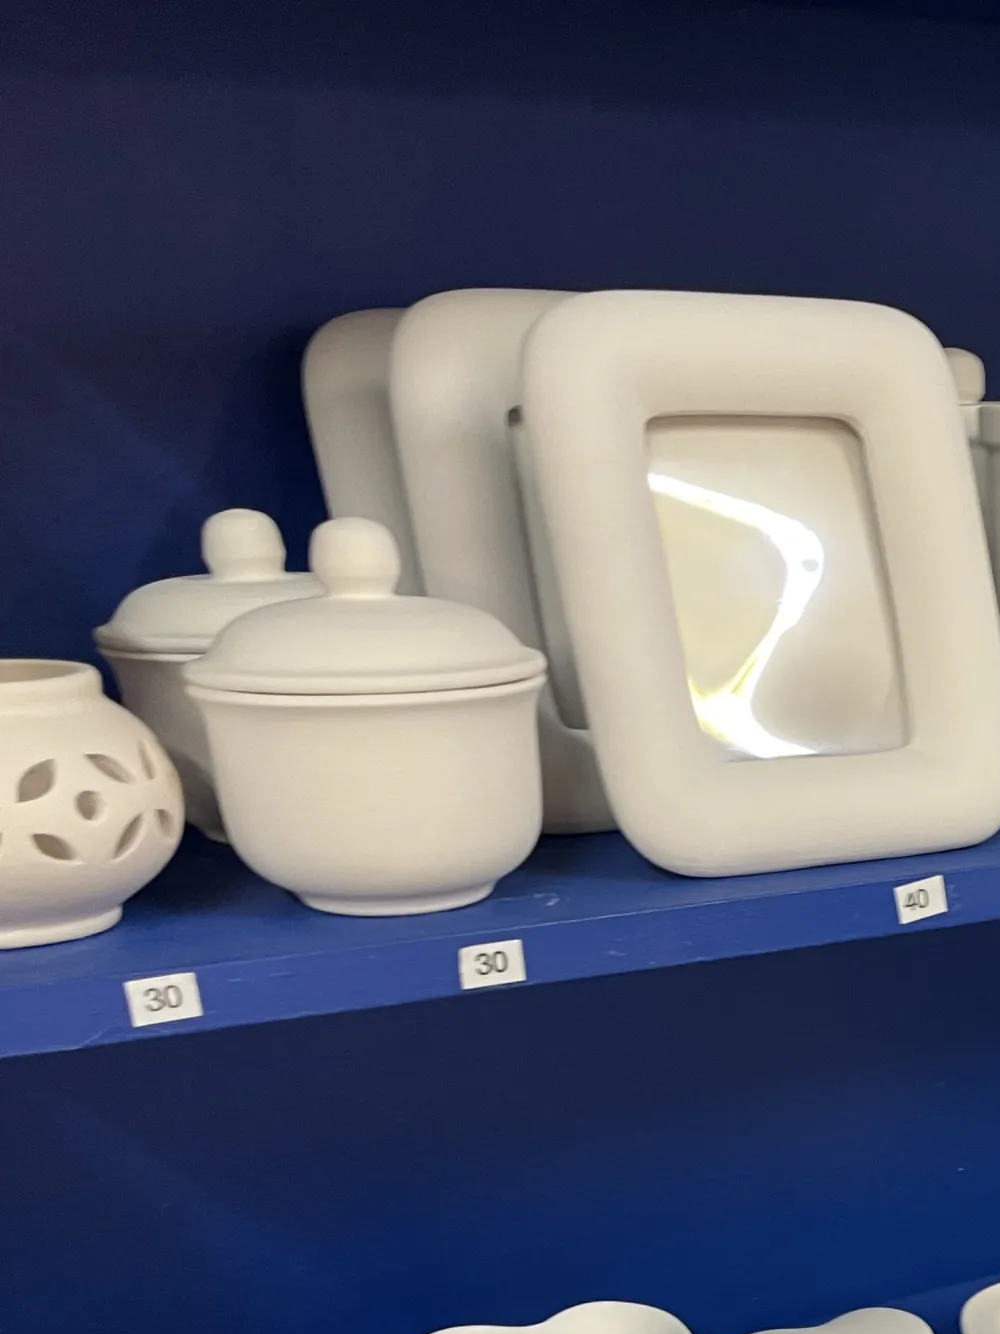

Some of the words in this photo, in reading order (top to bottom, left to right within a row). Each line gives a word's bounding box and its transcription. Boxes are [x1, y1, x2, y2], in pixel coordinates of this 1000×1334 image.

[903, 888, 929, 910] 40
[474, 951, 509, 976] 30
[144, 985, 184, 1012] 30
